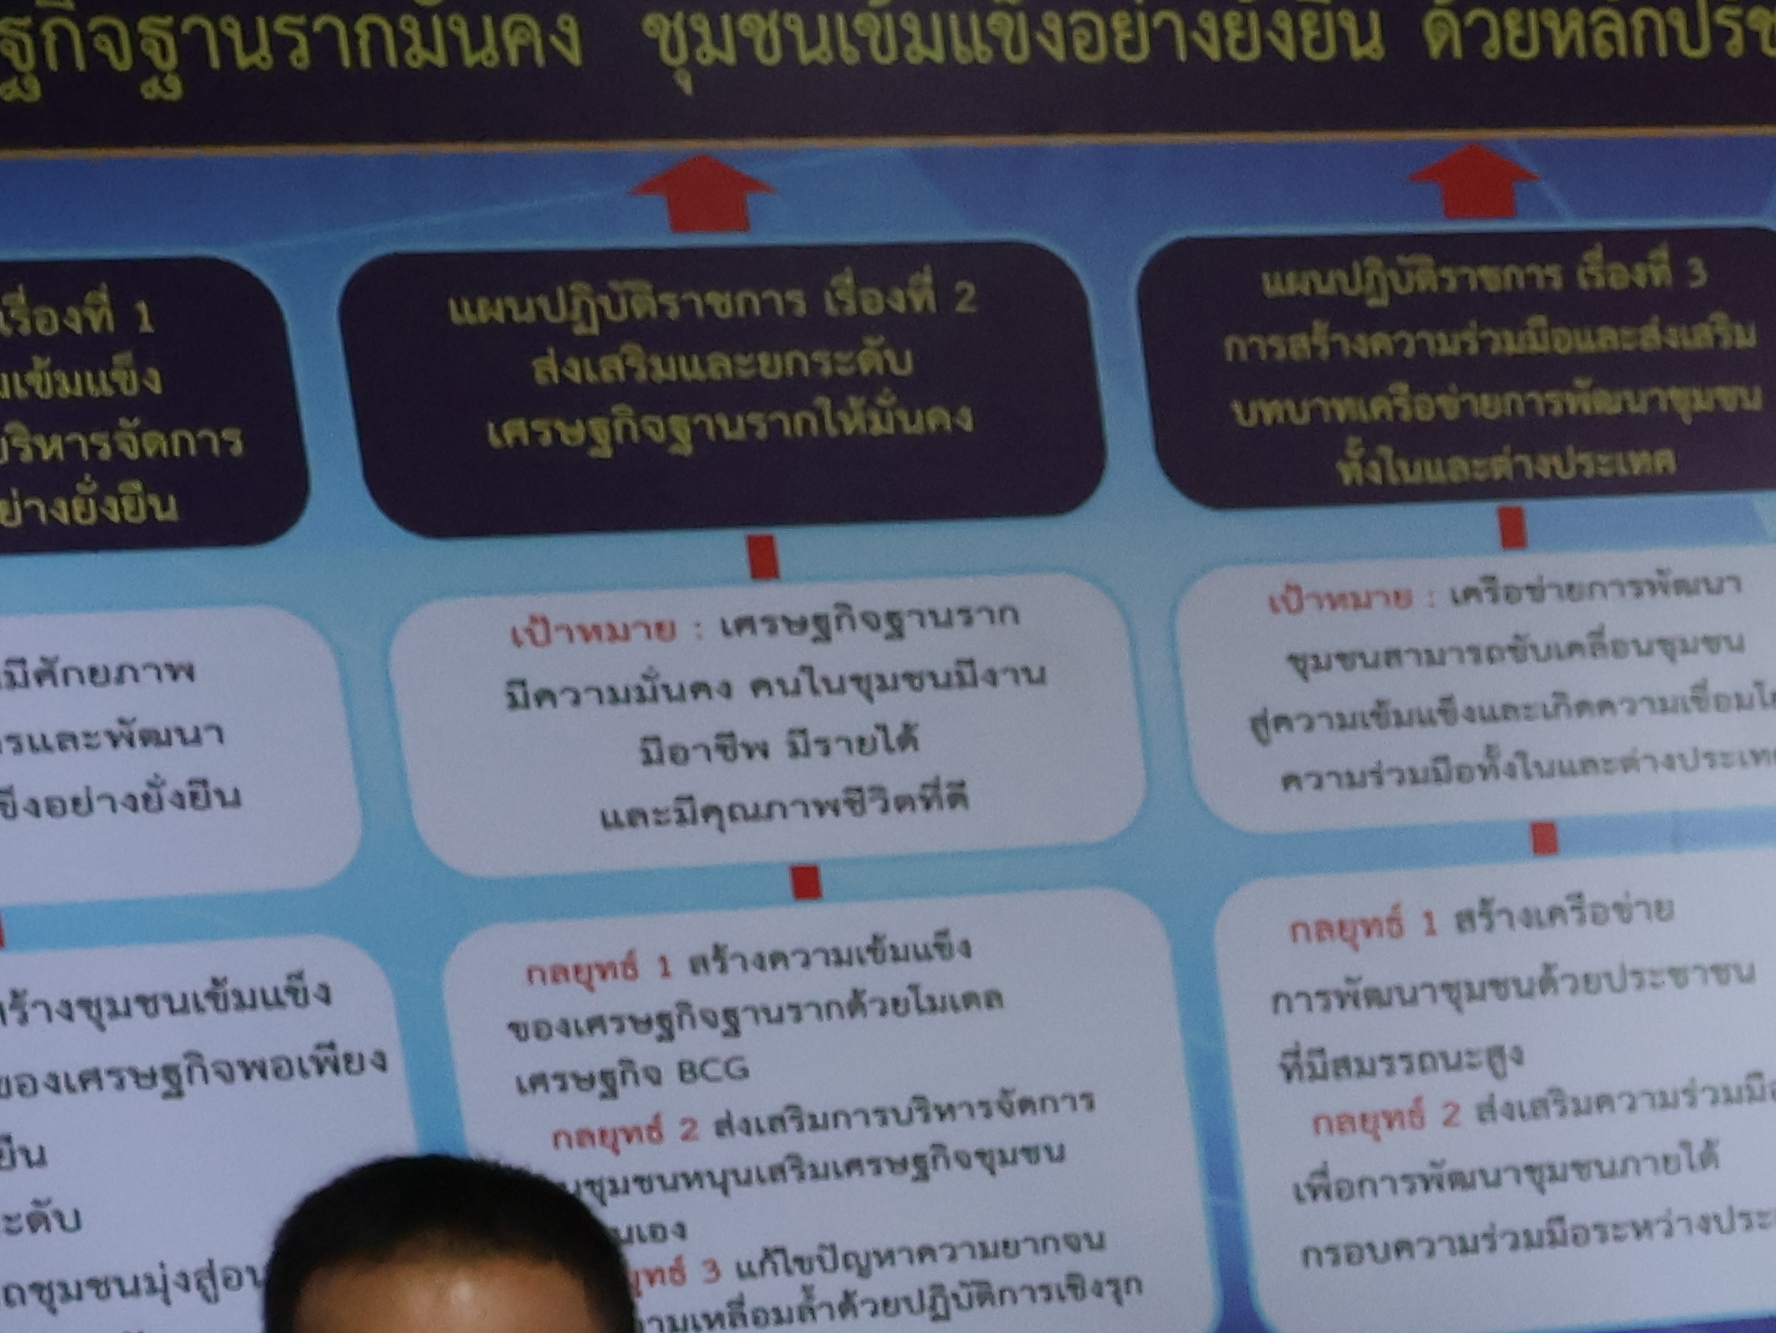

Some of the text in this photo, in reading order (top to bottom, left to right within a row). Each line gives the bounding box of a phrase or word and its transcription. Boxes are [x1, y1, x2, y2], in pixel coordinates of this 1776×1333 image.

[448, 266, 978, 335] แผนปฏิบัติราชการ เรื่องที่ 2
[1261, 243, 1708, 308] แผนปฏิบัติราชการ เรื่องที่ 3
[133, 300, 155, 335] 1
[531, 335, 913, 386] ส่งเสริมและยกระดับ
[488, 388, 974, 458] เศรษฐกิจฐานรากให้มั่นคง
[1337, 436, 1677, 487] ทั้งในและต่างประเทศ
[1268, 579, 1414, 617] เป้าหมาย
[1450, 567, 1742, 608] เครือข่ายการพัฒนา
[510, 612, 676, 650] เป้าหมาย
[721, 599, 1020, 644] เศรษฐกิจฐานราก
[505, 658, 1048, 711] มีความมั่นคง คนในชุมชนมีงาน
[639, 721, 919, 769] มีอาชีพ มีรายได้
[600, 775, 969, 835] และมีคุณภาพชีวิตที่ดี
[1290, 891, 1675, 951] กลยุทธ์ 1 สร้างเครือข่าย
[526, 929, 973, 995] กลยุทธ์ 1 สร้างความเข้มแข็ง
[507, 982, 1005, 1043] ของเศรษฐกิจฐานรากด้วยโมเดล
[516, 1057, 750, 1101] เศรษฐกิจ BCG
[1278, 1041, 1525, 1085] ที่มีสมรรถนะสูง
[551, 1087, 1097, 1157] กลยุทธ์ 2 ส่งเสริมการบริหารจัดการ
[1312, 1096, 1427, 1142] กลยุทธ์
[1442, 1101, 1460, 1127] 2
[1294, 1138, 1720, 1205] เพื่อการพัฒนาชุมชนภายใต้
[704, 1259, 722, 1285] 3
[736, 1227, 1106, 1282] แก้ไขปัญหาความยากจน
